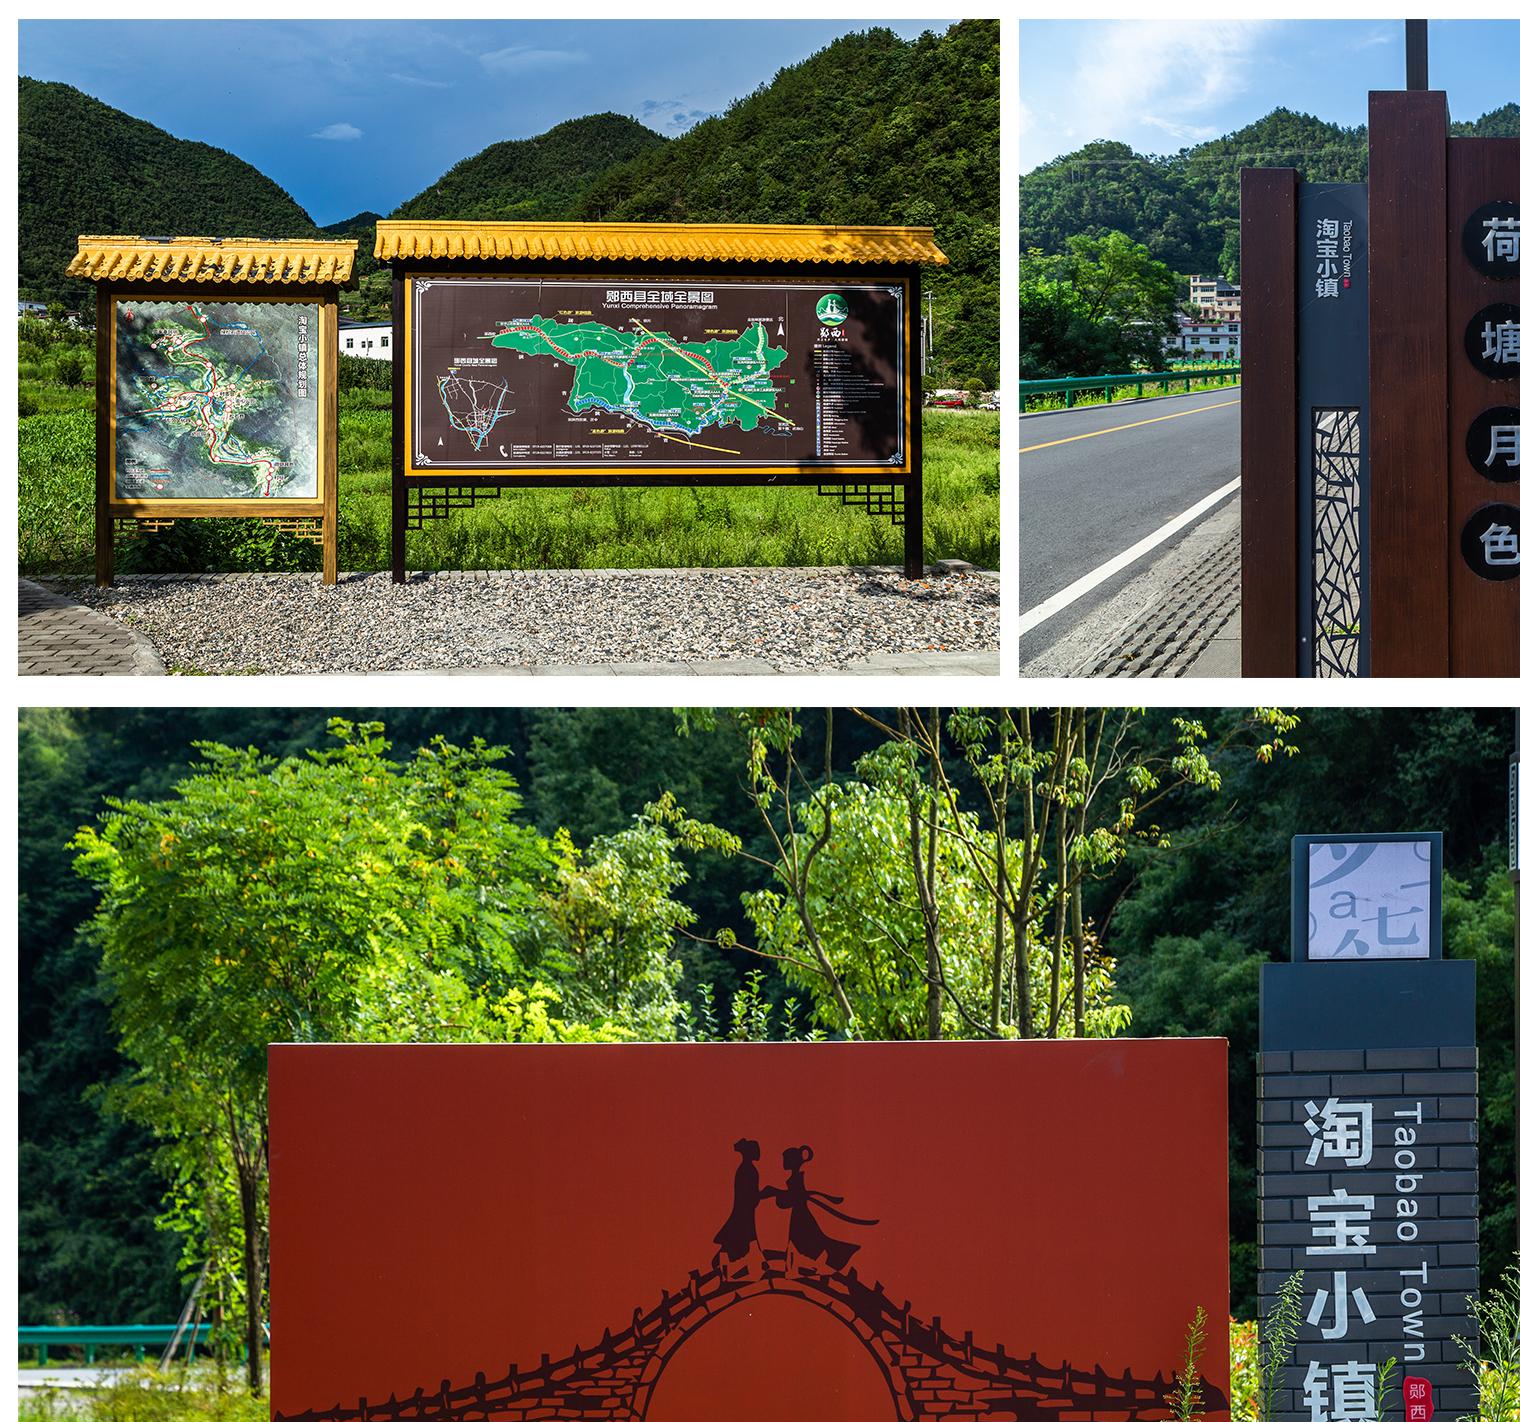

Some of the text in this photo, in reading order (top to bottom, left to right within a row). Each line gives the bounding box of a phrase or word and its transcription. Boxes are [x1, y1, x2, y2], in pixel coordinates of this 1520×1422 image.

[1343, 220, 1352, 252] Taobao
[1316, 218, 1339, 298] 淘宝小镇
[1343, 253, 1352, 278] Town
[606, 291, 714, 303] 郧西县全域全景图
[621, 302, 669, 310] Comprehensive
[1394, 1101, 1428, 1362] Taobao Town
[1409, 1383, 1427, 1421] 郧西
